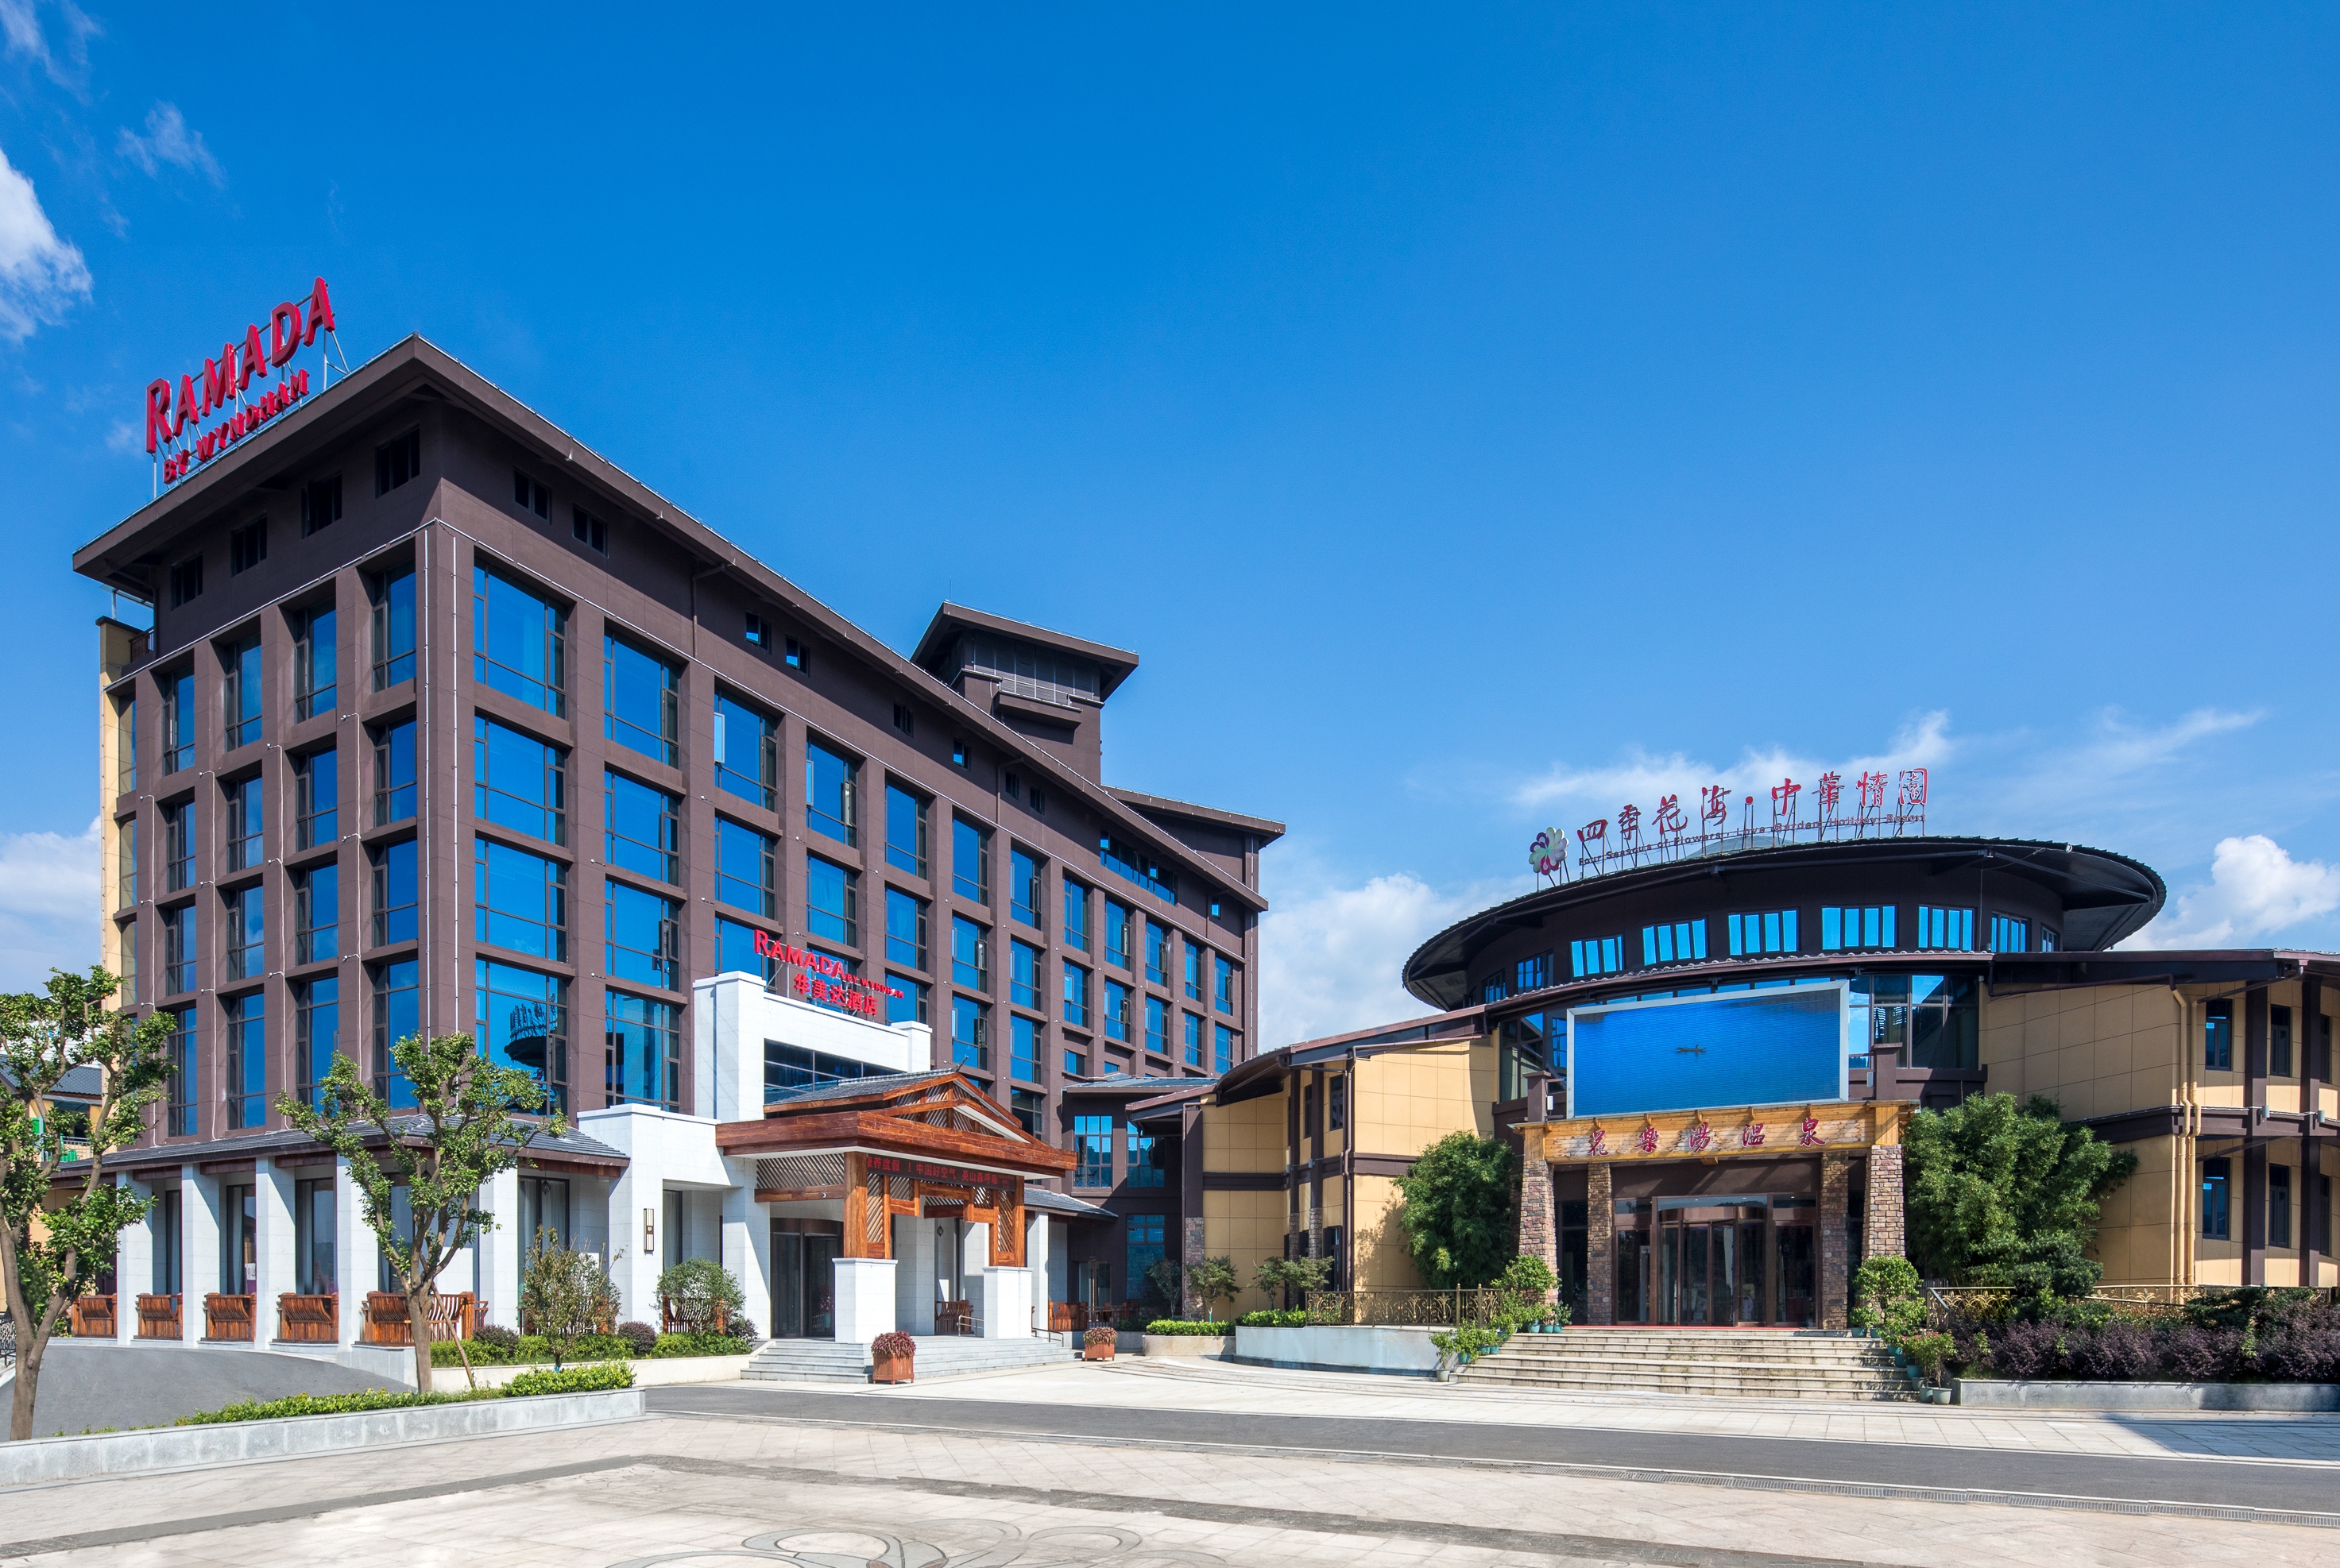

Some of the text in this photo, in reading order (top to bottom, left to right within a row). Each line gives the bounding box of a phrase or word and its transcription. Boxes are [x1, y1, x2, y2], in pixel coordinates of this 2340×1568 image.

[145, 276, 335, 454] RAMADA
[163, 368, 308, 485] BY WYNDHAM
[1673, 832, 1721, 846] Flowers
[1773, 820, 1821, 832] Garden
[1829, 816, 1877, 828] Holiday
[1886, 813, 1926, 822] Resort
[754, 929, 846, 980] RAMADA
[845, 973, 858, 983] BY
[793, 973, 879, 1016] 华美达酒店
